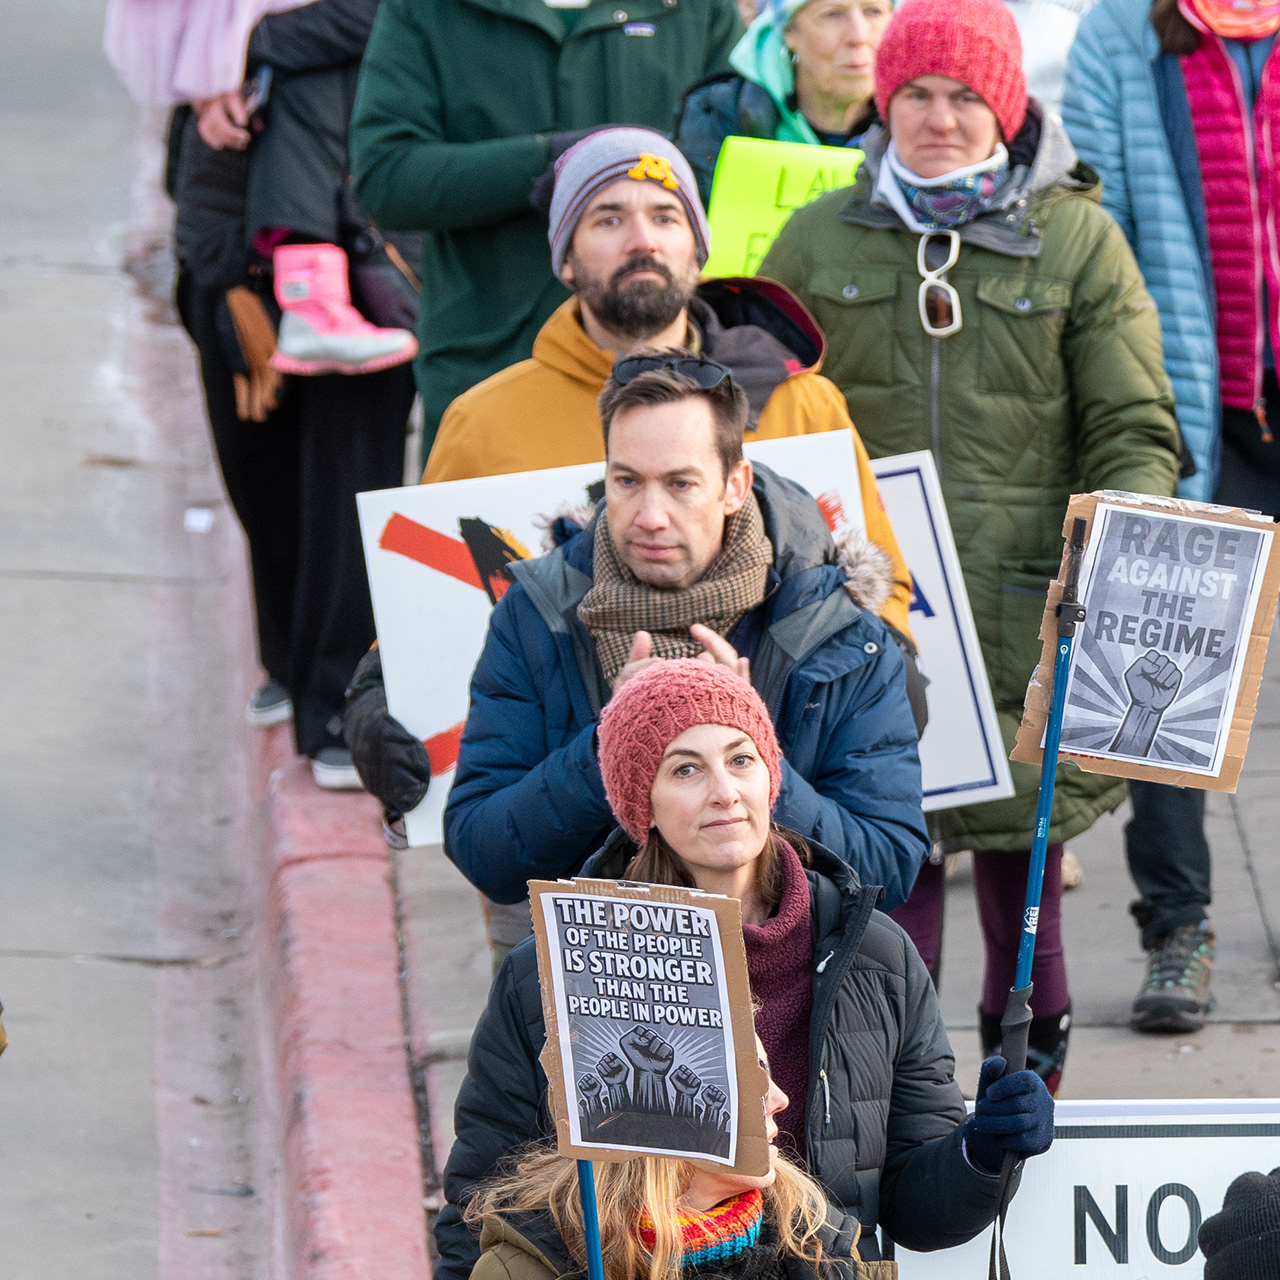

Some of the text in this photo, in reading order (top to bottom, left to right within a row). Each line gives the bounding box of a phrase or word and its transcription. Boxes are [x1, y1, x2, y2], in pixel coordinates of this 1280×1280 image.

[1119, 515, 1242, 570] RAGE
[1106, 556, 1239, 601] AGAINST
[1140, 590, 1197, 623] THE
[1093, 610, 1226, 660] REGIME
[555, 898, 711, 938] THE POWER
[565, 927, 703, 958] OF THE PEOPLE
[563, 948, 714, 985] IS STRONGER
[594, 977, 690, 1004] THAN THE
[567, 995, 723, 1029] PEOPLE IN POWER
[1074, 1182, 1202, 1267] NO
